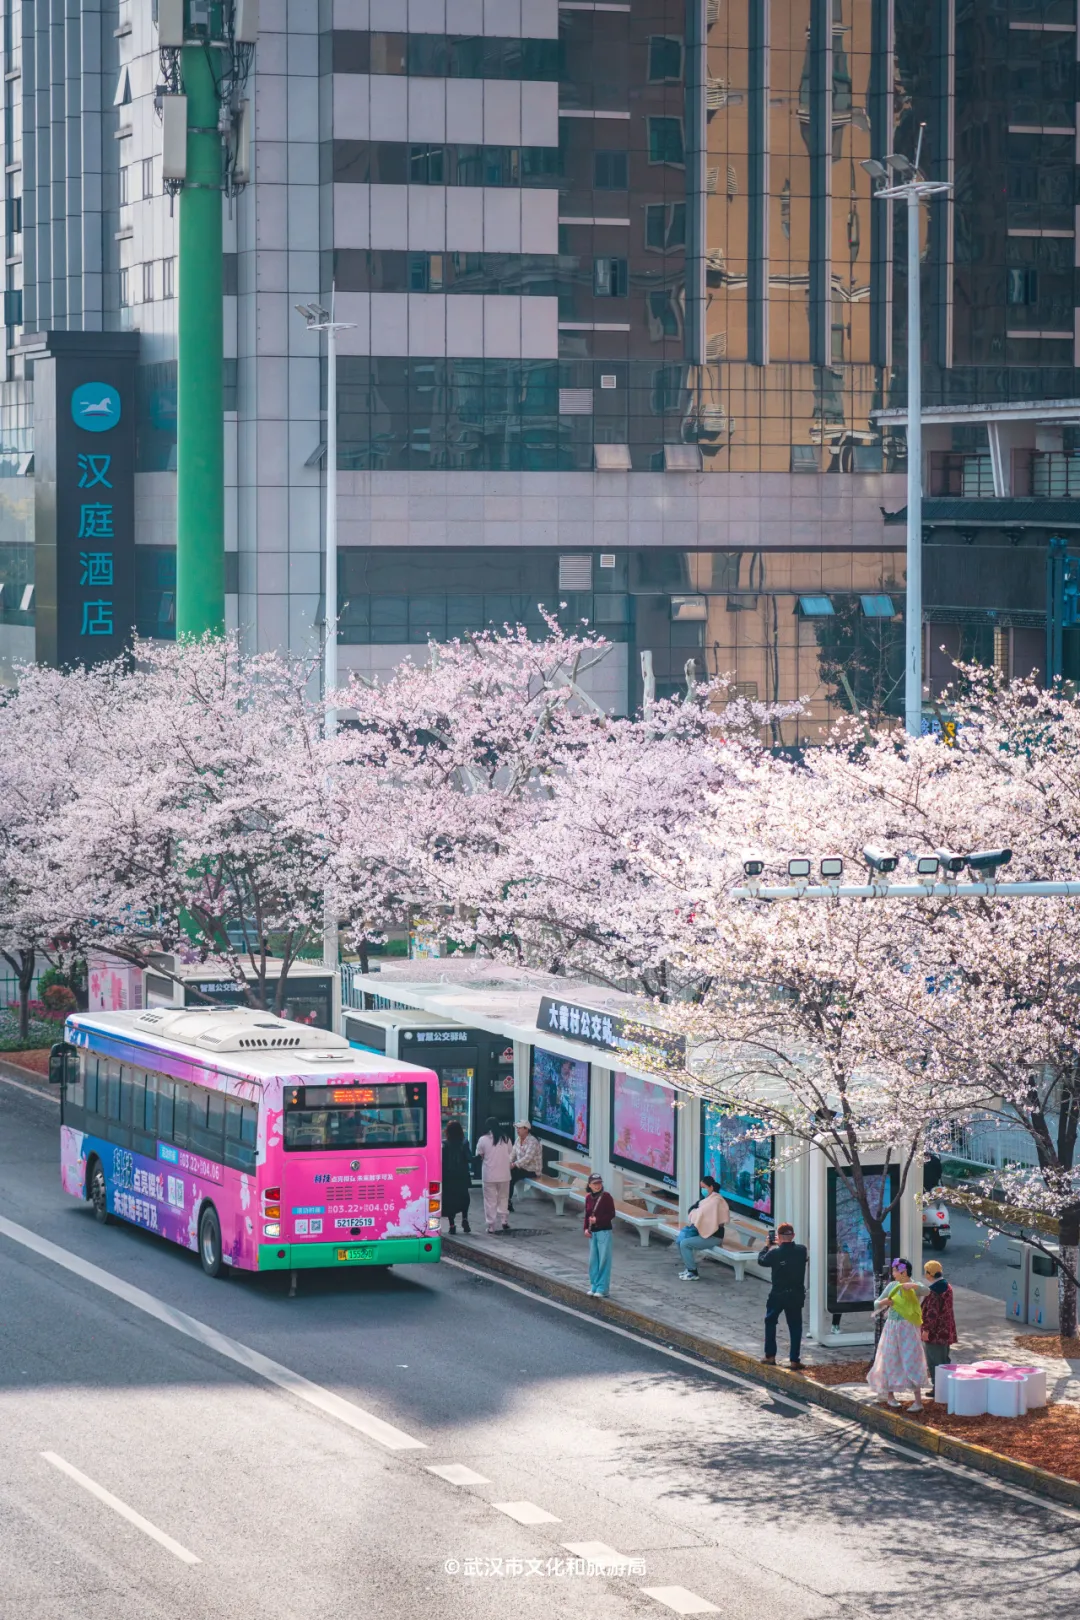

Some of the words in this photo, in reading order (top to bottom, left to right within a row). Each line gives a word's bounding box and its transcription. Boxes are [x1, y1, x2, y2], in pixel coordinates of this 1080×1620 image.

[77, 453, 115, 635] 汉庭酒店
[416, 1032, 468, 1041] 智慧公交驿站
[337, 1219, 373, 1227] 521F2519
